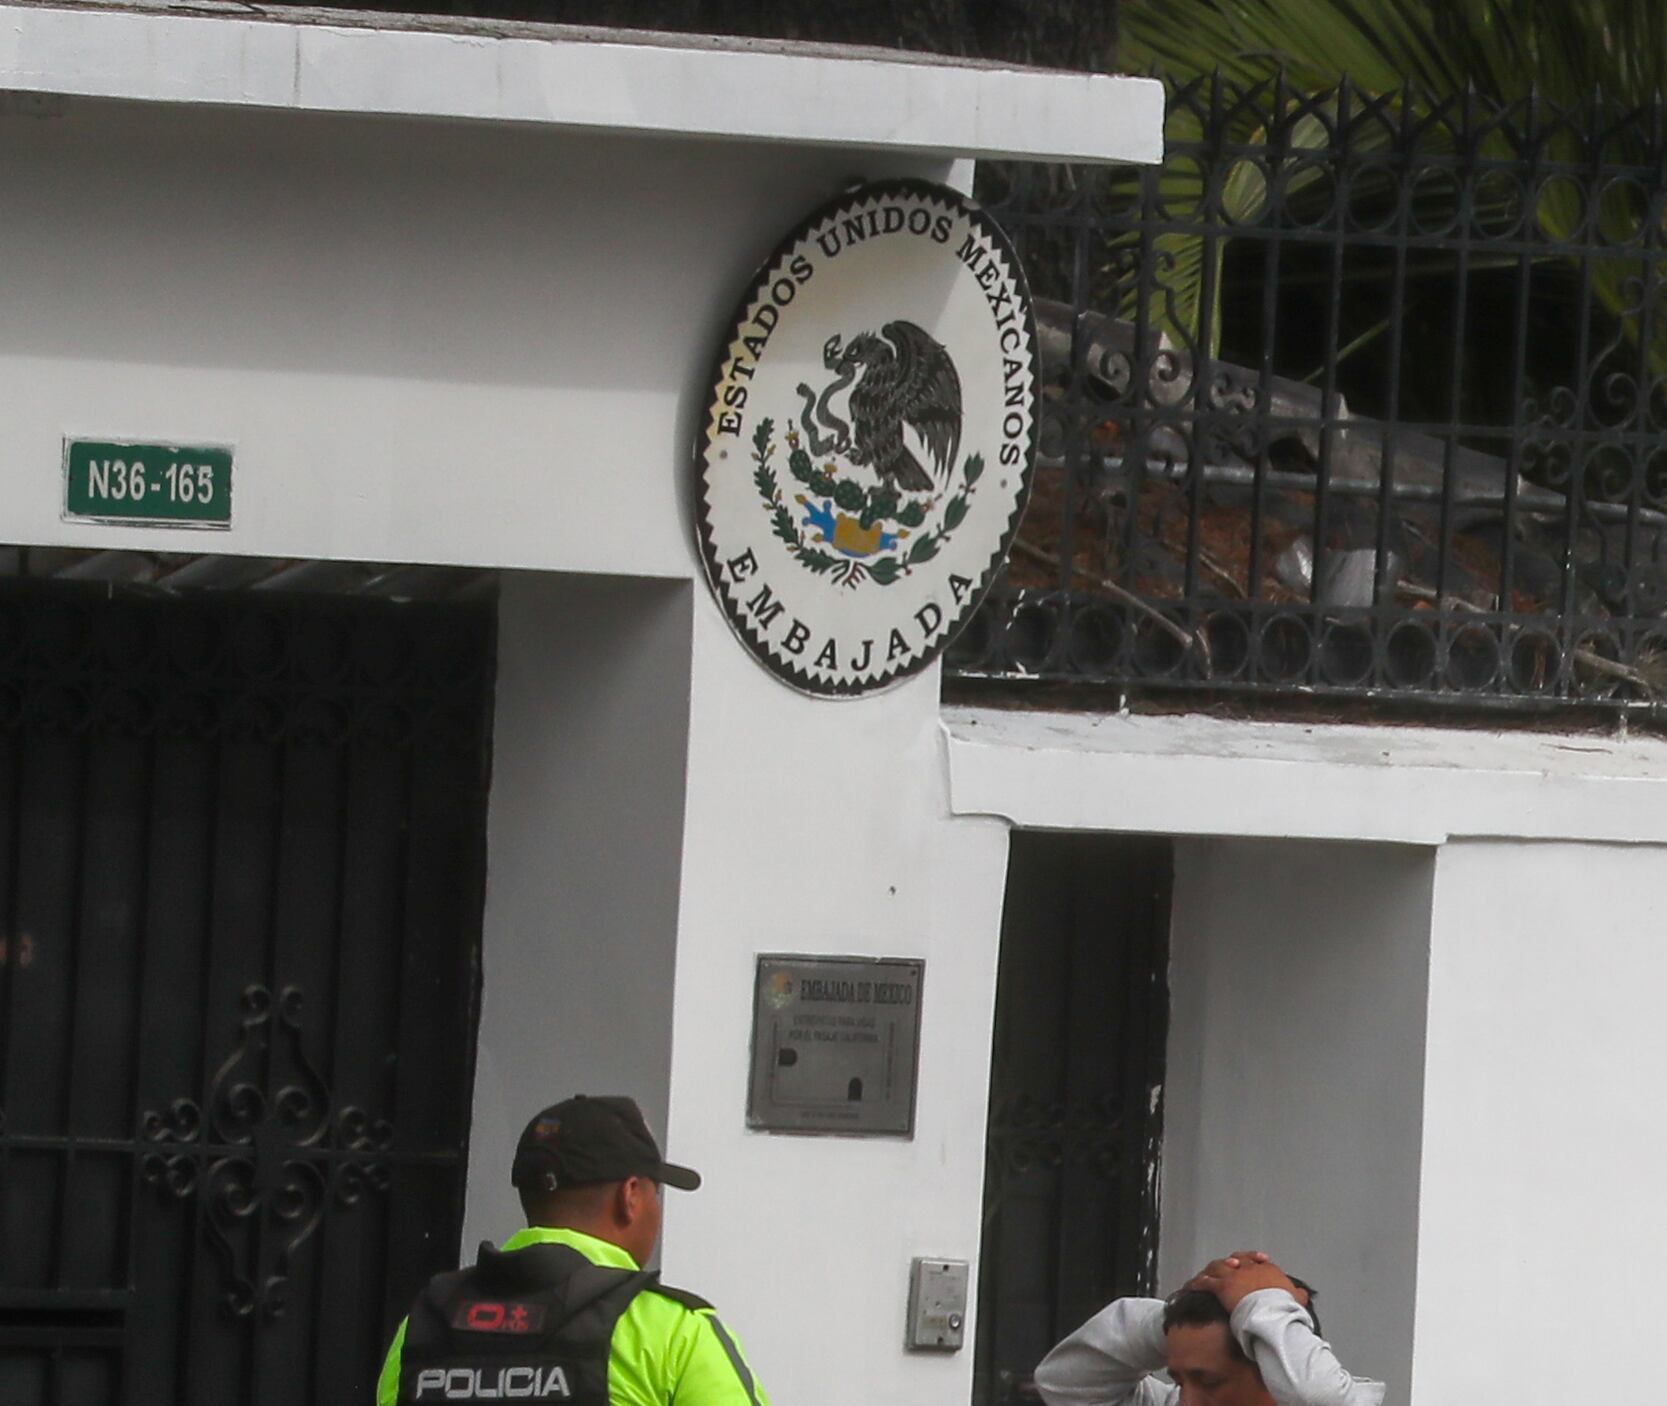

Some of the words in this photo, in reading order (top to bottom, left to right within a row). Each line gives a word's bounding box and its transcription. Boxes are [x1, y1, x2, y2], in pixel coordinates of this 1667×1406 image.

[718, 254, 815, 438] ESTADOS
[815, 205, 954, 259] UNIDOS
[954, 234, 1022, 467] MEXICANOS
[87, 459, 214, 504] N36-165
[727, 547, 973, 672] EMBAJADA
[416, 1366, 571, 1399] POLICIA
